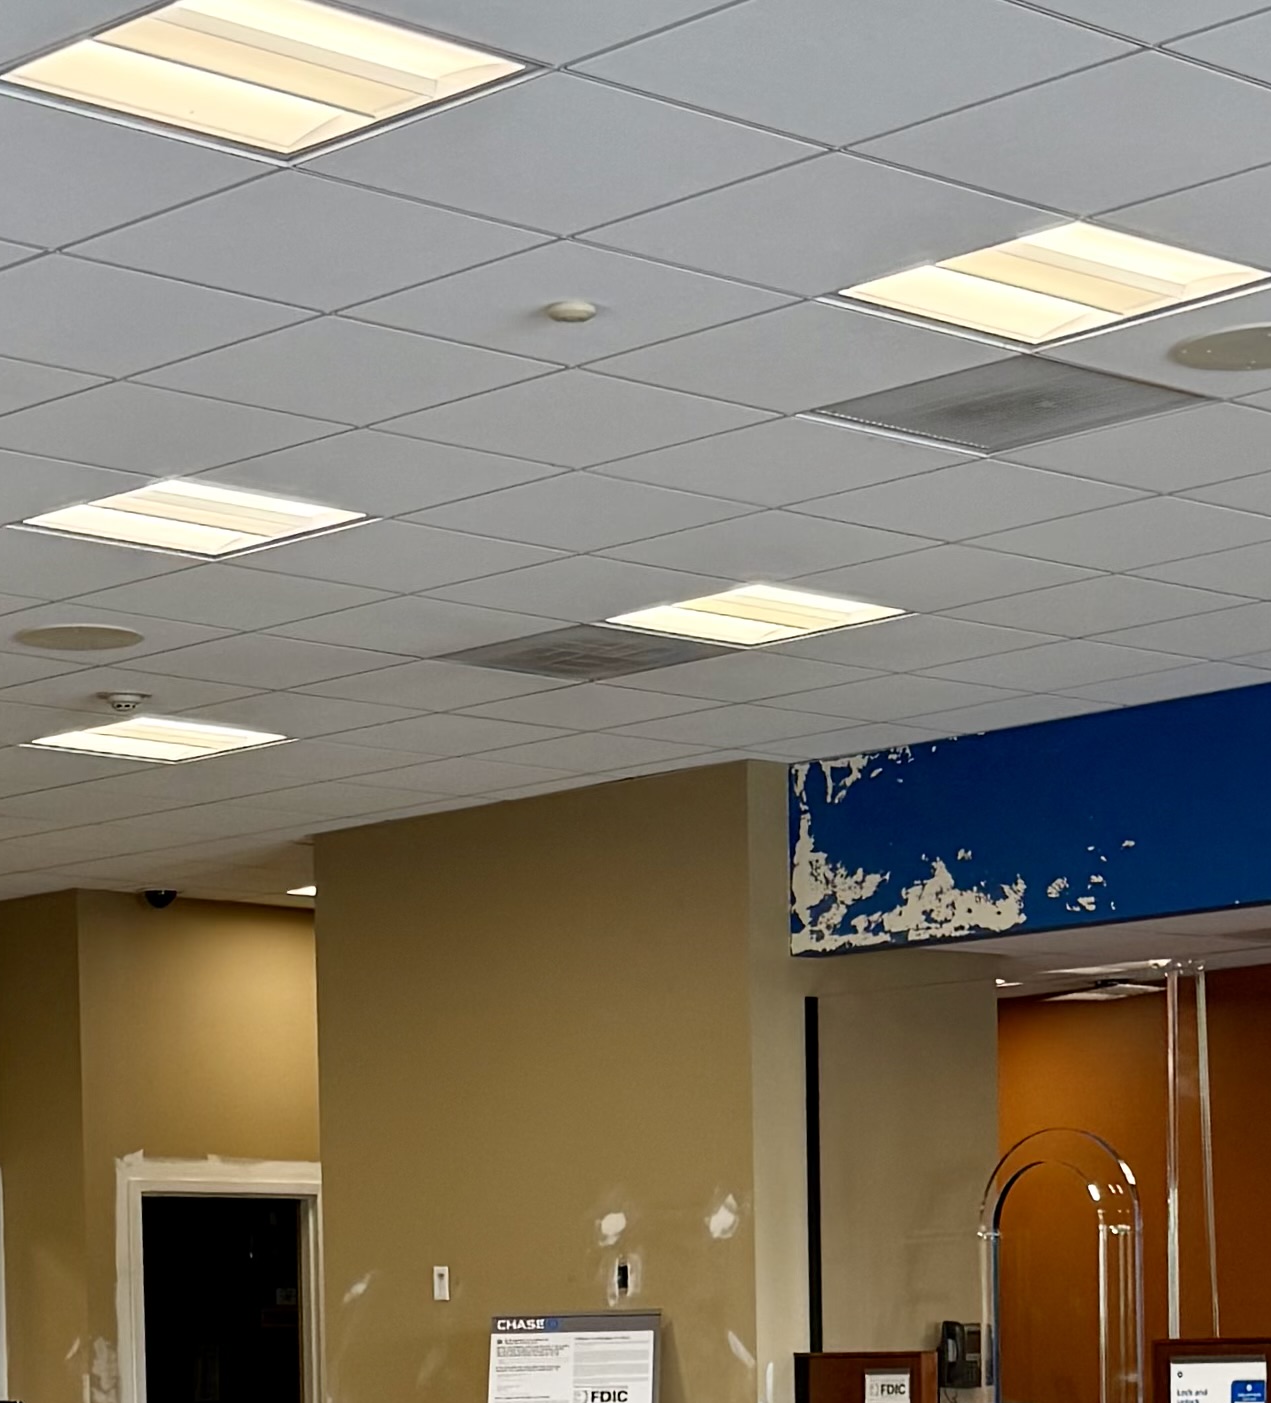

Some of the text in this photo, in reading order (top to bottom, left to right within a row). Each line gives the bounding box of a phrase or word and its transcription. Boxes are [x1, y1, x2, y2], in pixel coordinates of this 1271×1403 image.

[496, 1319, 545, 1331] CHASE
[880, 1383, 906, 1396] FDIC
[1177, 1389, 1193, 1397] Lock
[590, 1390, 629, 1403] FDIC
